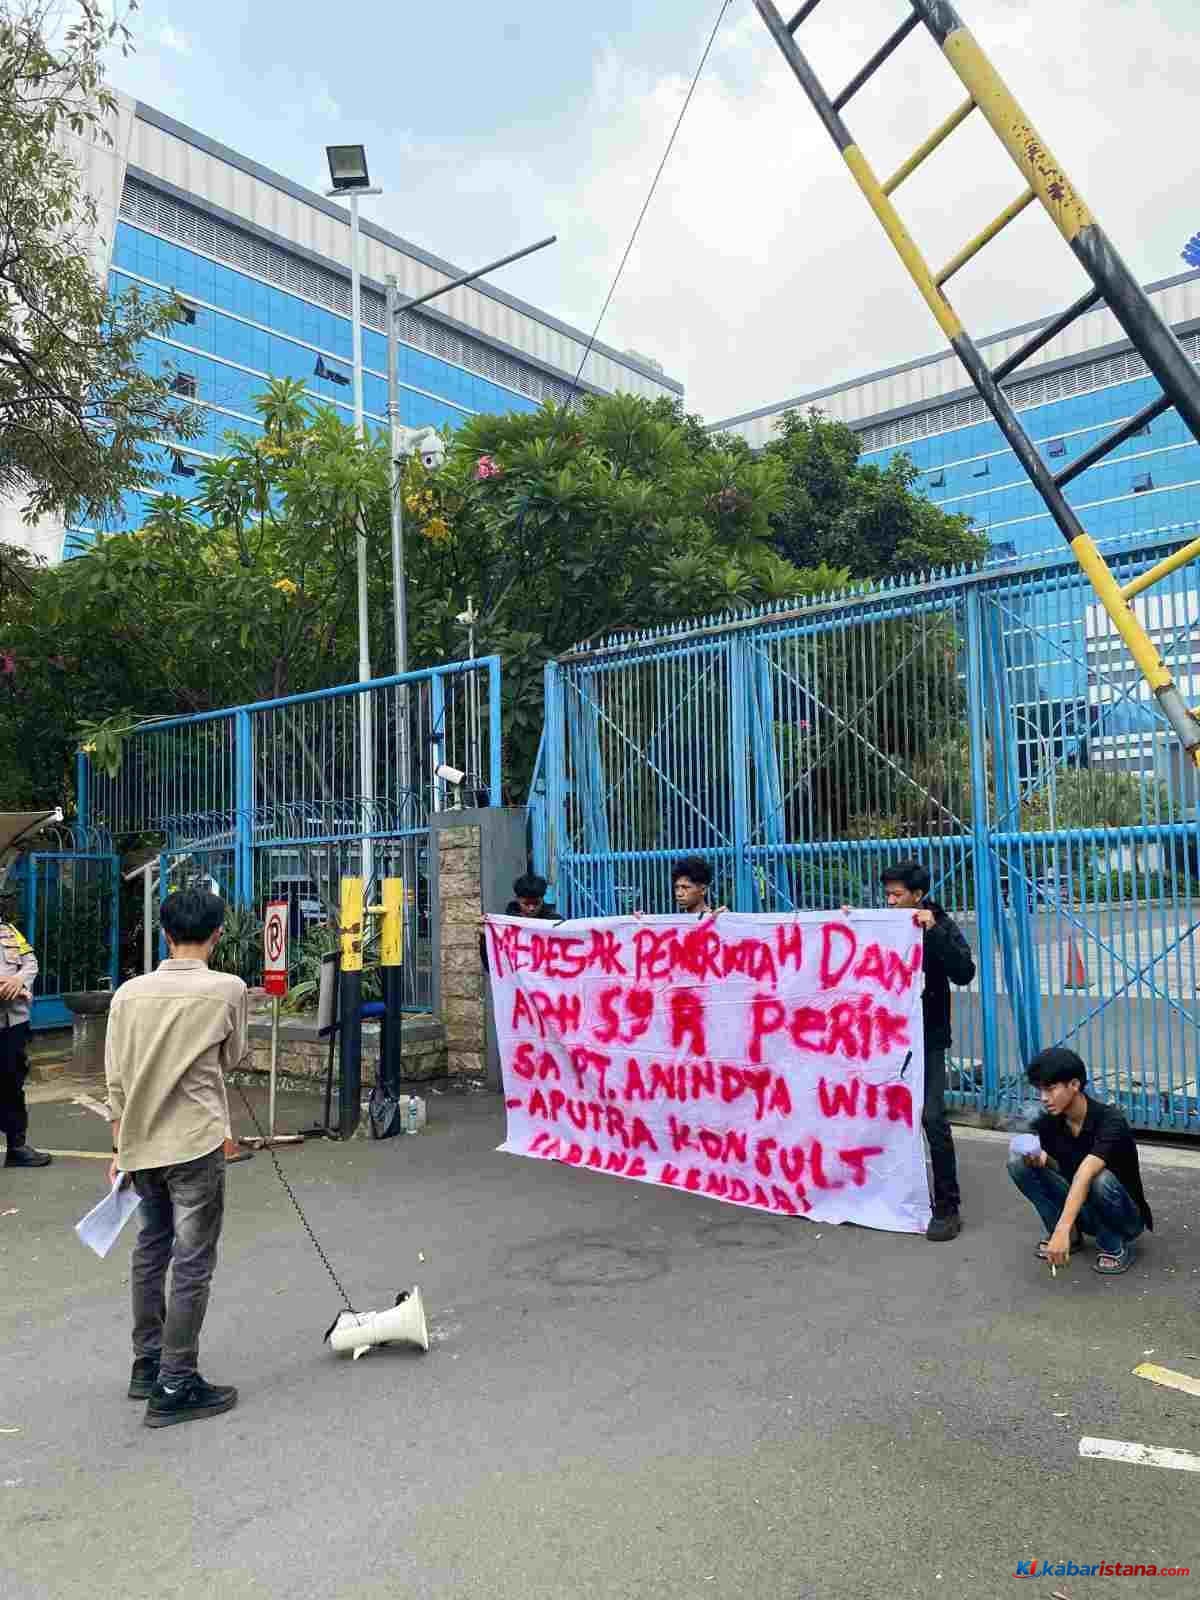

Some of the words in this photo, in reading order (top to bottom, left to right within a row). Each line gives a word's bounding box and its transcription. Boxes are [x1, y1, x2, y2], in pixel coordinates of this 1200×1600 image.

[820, 921, 921, 994] DAN
[512, 987, 581, 1038] APH
[513, 1042, 561, 1080] SA
[668, 1114, 884, 1189] KONSULT
